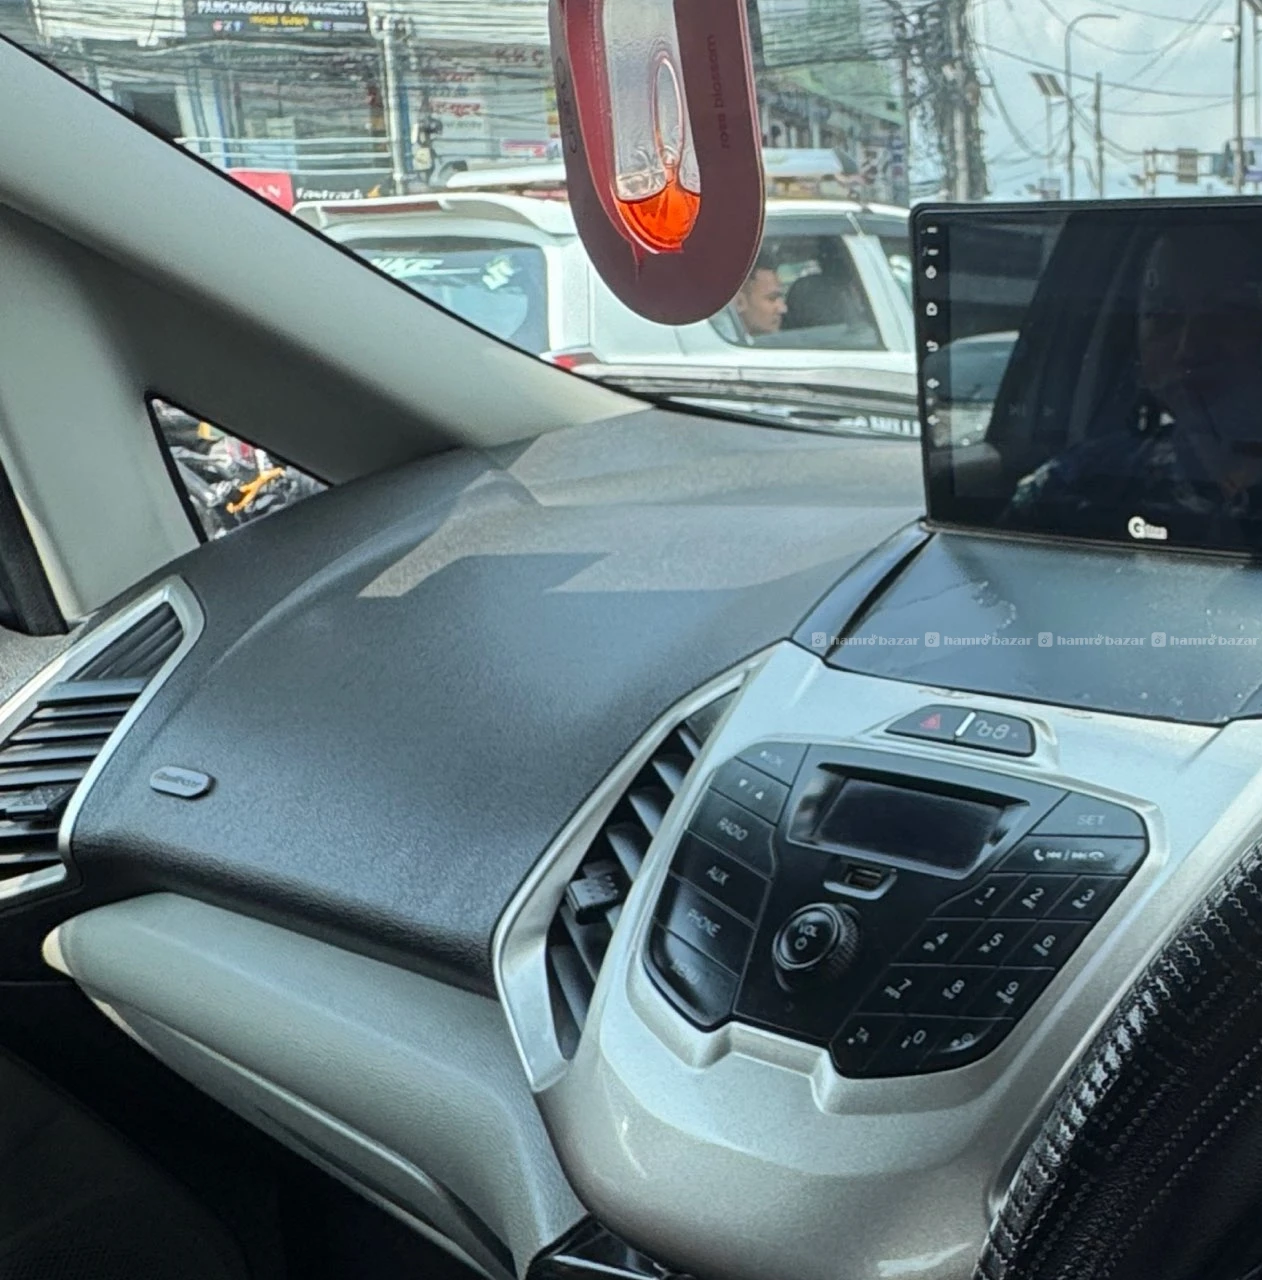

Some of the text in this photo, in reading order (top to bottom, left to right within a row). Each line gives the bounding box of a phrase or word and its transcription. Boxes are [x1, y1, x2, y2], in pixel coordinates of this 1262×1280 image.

[1076, 814, 1105, 825] SET
[1030, 887, 1045, 901] 2
[1081, 888, 1095, 901] 3
[989, 933, 1004, 946] 5
[1042, 935, 1056, 948] 6
[898, 978, 912, 991] 7
[951, 979, 965, 994] 8
[1006, 981, 1020, 995] 9
